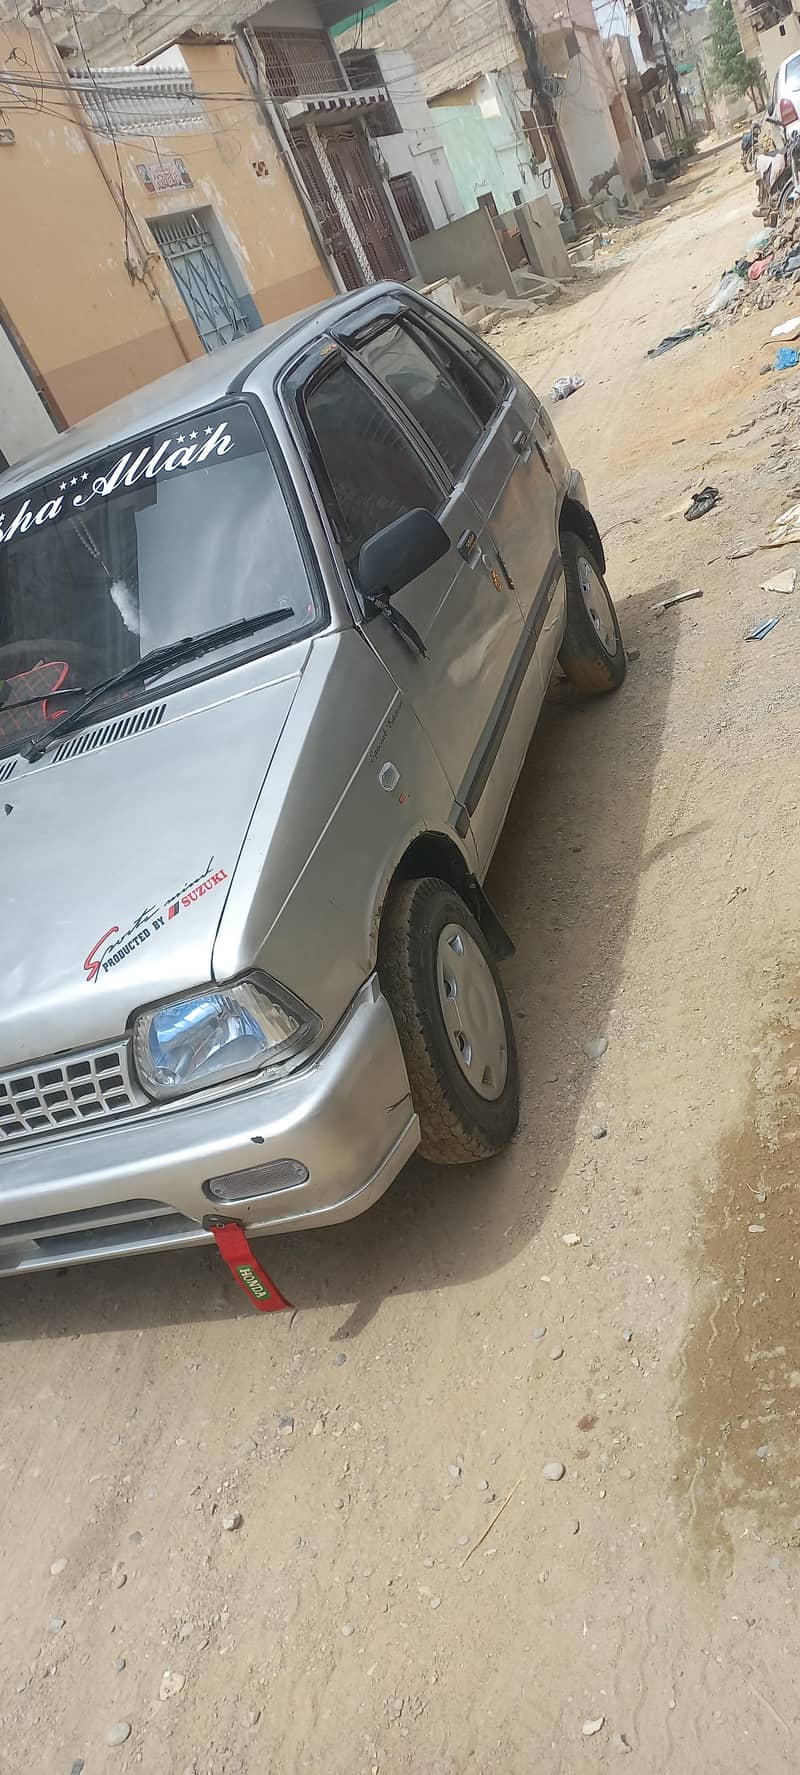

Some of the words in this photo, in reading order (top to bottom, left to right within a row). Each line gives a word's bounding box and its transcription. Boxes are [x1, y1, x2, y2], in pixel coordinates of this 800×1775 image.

[73, 422, 235, 507] Allah
[102, 928, 151, 973] PRODUCTED
[151, 916, 166, 931] BY
[180, 869, 229, 908] SUZUKI
[239, 1268, 267, 1298] HONDA
